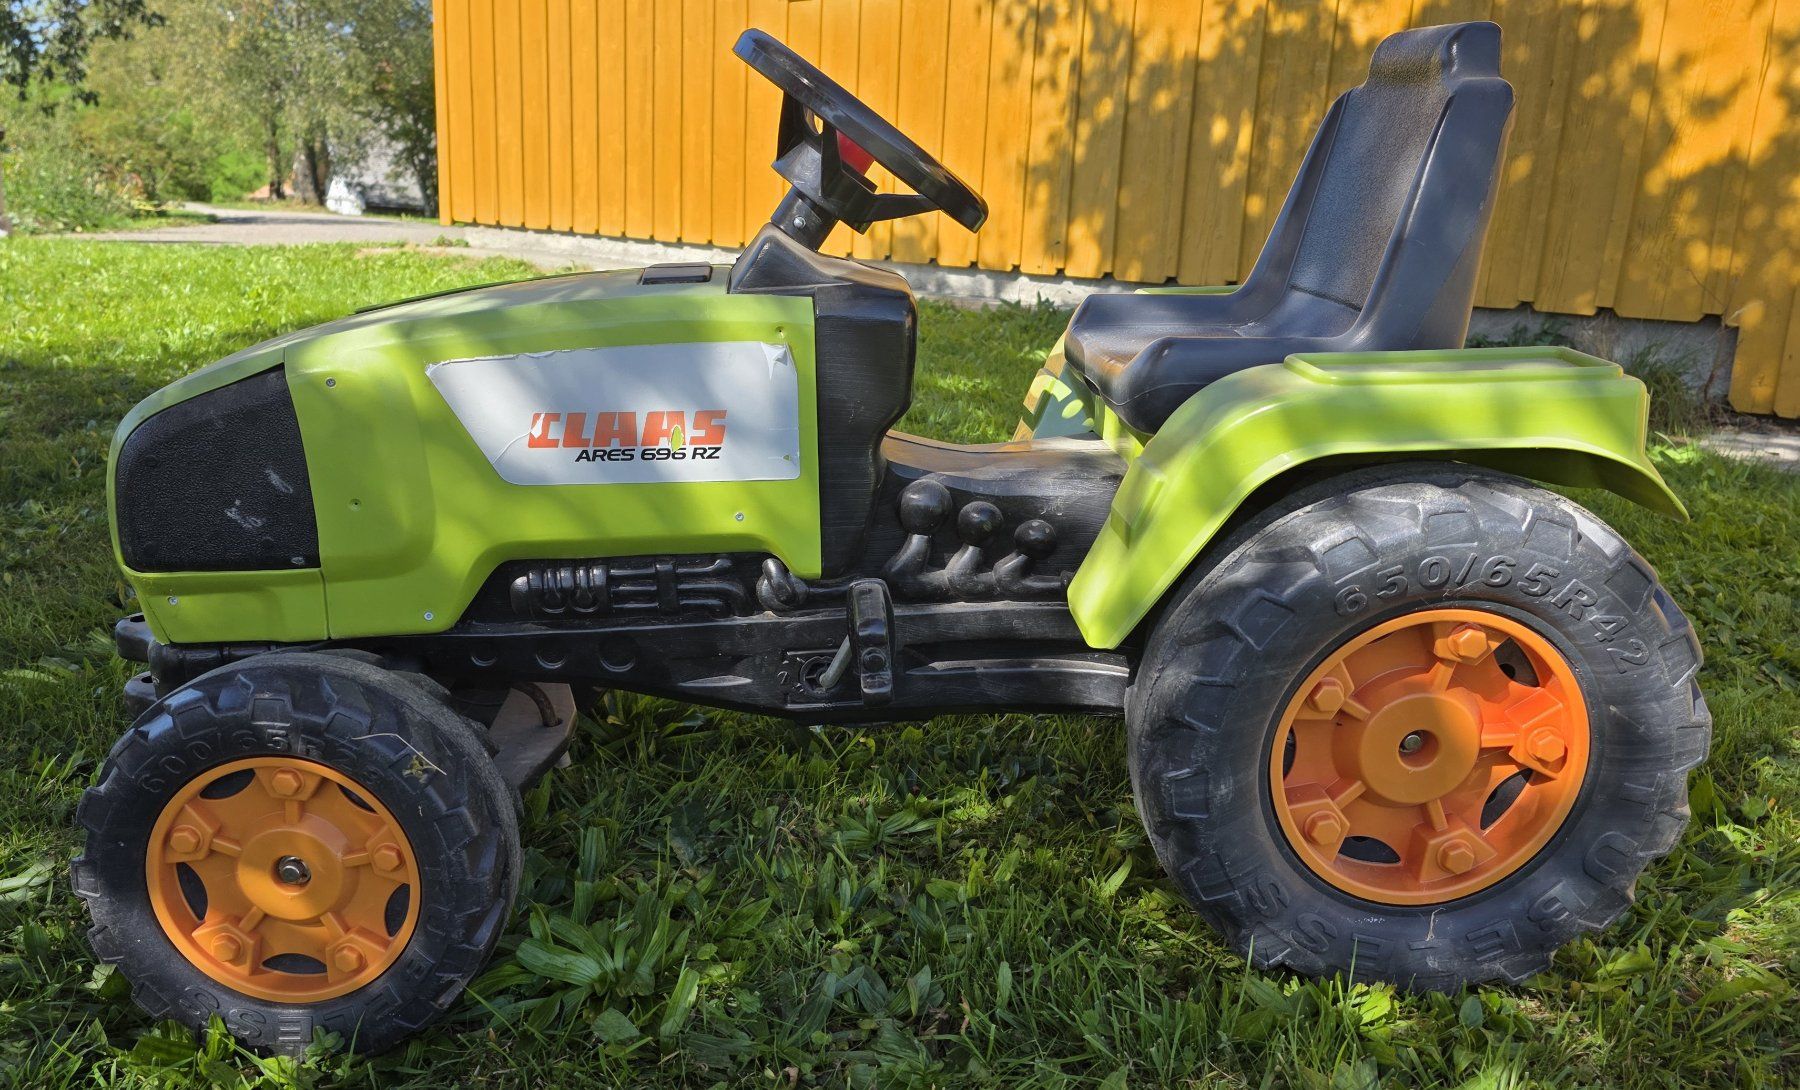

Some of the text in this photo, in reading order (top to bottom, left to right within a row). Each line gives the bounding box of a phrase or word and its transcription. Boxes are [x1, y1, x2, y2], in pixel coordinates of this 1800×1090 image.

[528, 410, 727, 448] CLAAS
[575, 446, 721, 462] ARES 696 RZ
[1333, 552, 1650, 674] 650/65R42
